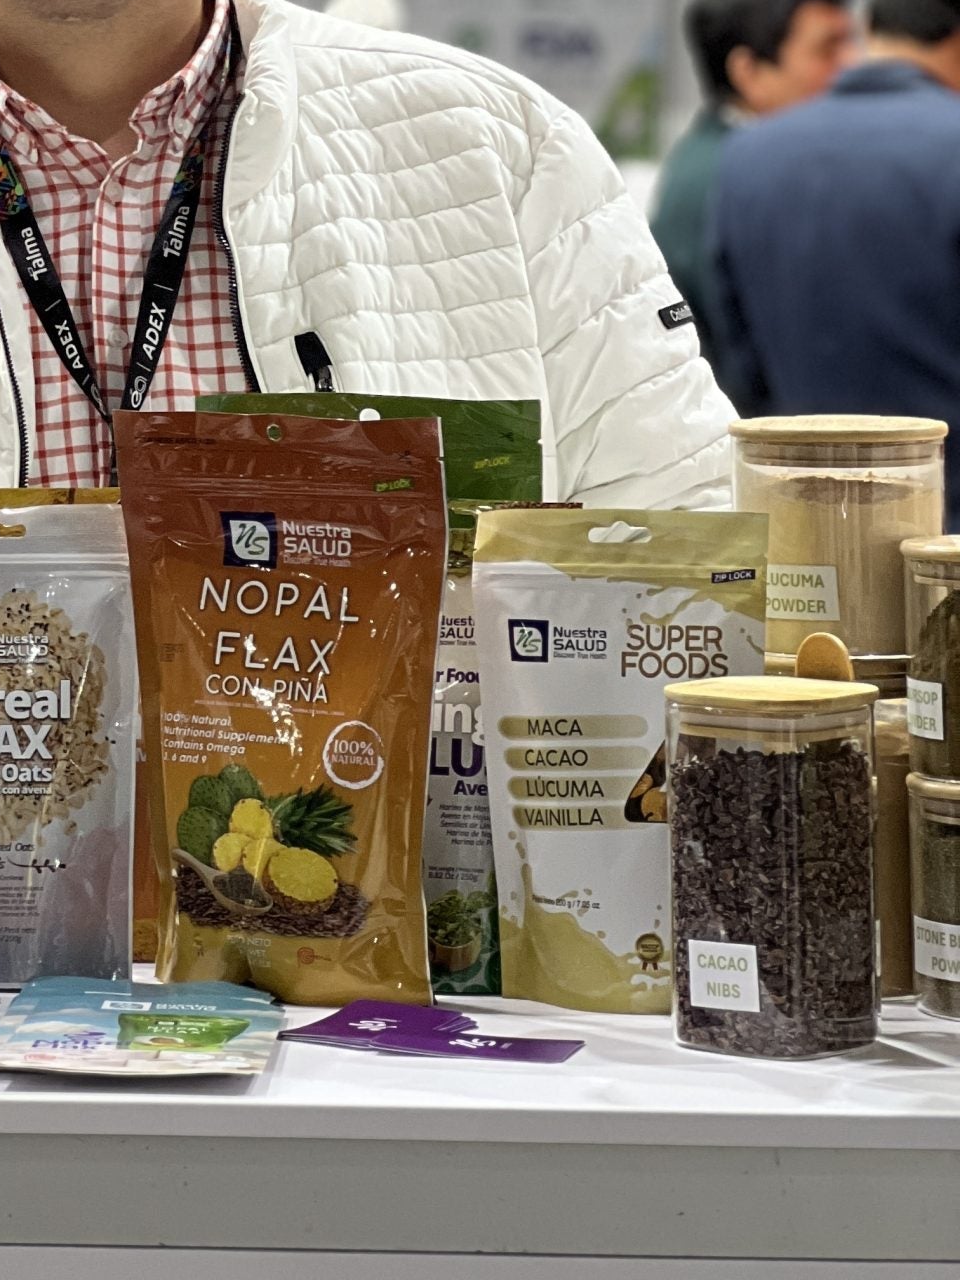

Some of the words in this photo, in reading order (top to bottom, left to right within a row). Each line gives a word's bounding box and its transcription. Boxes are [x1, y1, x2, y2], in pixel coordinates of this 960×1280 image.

[143, 301, 167, 360] ADEX
[54, 319, 85, 370] ADEX
[282, 520, 352, 539] Nuestra
[283, 537, 352, 557] SALUD
[714, 574, 727, 582] ZIP
[729, 571, 752, 581] LOCK
[767, 573, 825, 588] UCUMA
[199, 576, 359, 622] NOPAL
[440, 627, 474, 639] SALU
[553, 626, 607, 639] Nuestra
[626, 624, 723, 652] SUPER
[214, 631, 334, 675] FLAX
[553, 639, 607, 652] SALUD
[621, 651, 729, 679] FOODS
[447, 668, 480, 683] Foo
[205, 674, 261, 698] CON
[273, 677, 328, 704] PIÑA
[191, 715, 232, 727] Natural
[527, 719, 583, 737] MACA
[164, 726, 215, 739] Nutritional
[217, 729, 290, 744] Supplemen
[163, 738, 204, 751] Contains
[206, 742, 246, 755] Omega
[333, 739, 375, 756] 100%
[179, 754, 199, 764] and
[331, 752, 377, 767] NATURAL
[524, 749, 589, 767] CACAO
[2, 764, 53, 783] Oats
[454, 780, 488, 796] Ave
[526, 776, 605, 797] LÚCUMA
[524, 808, 604, 826] VAINILLA
[697, 953, 748, 972] CACAO
[931, 956, 960, 974] POW
[706, 982, 741, 998] NIBS
